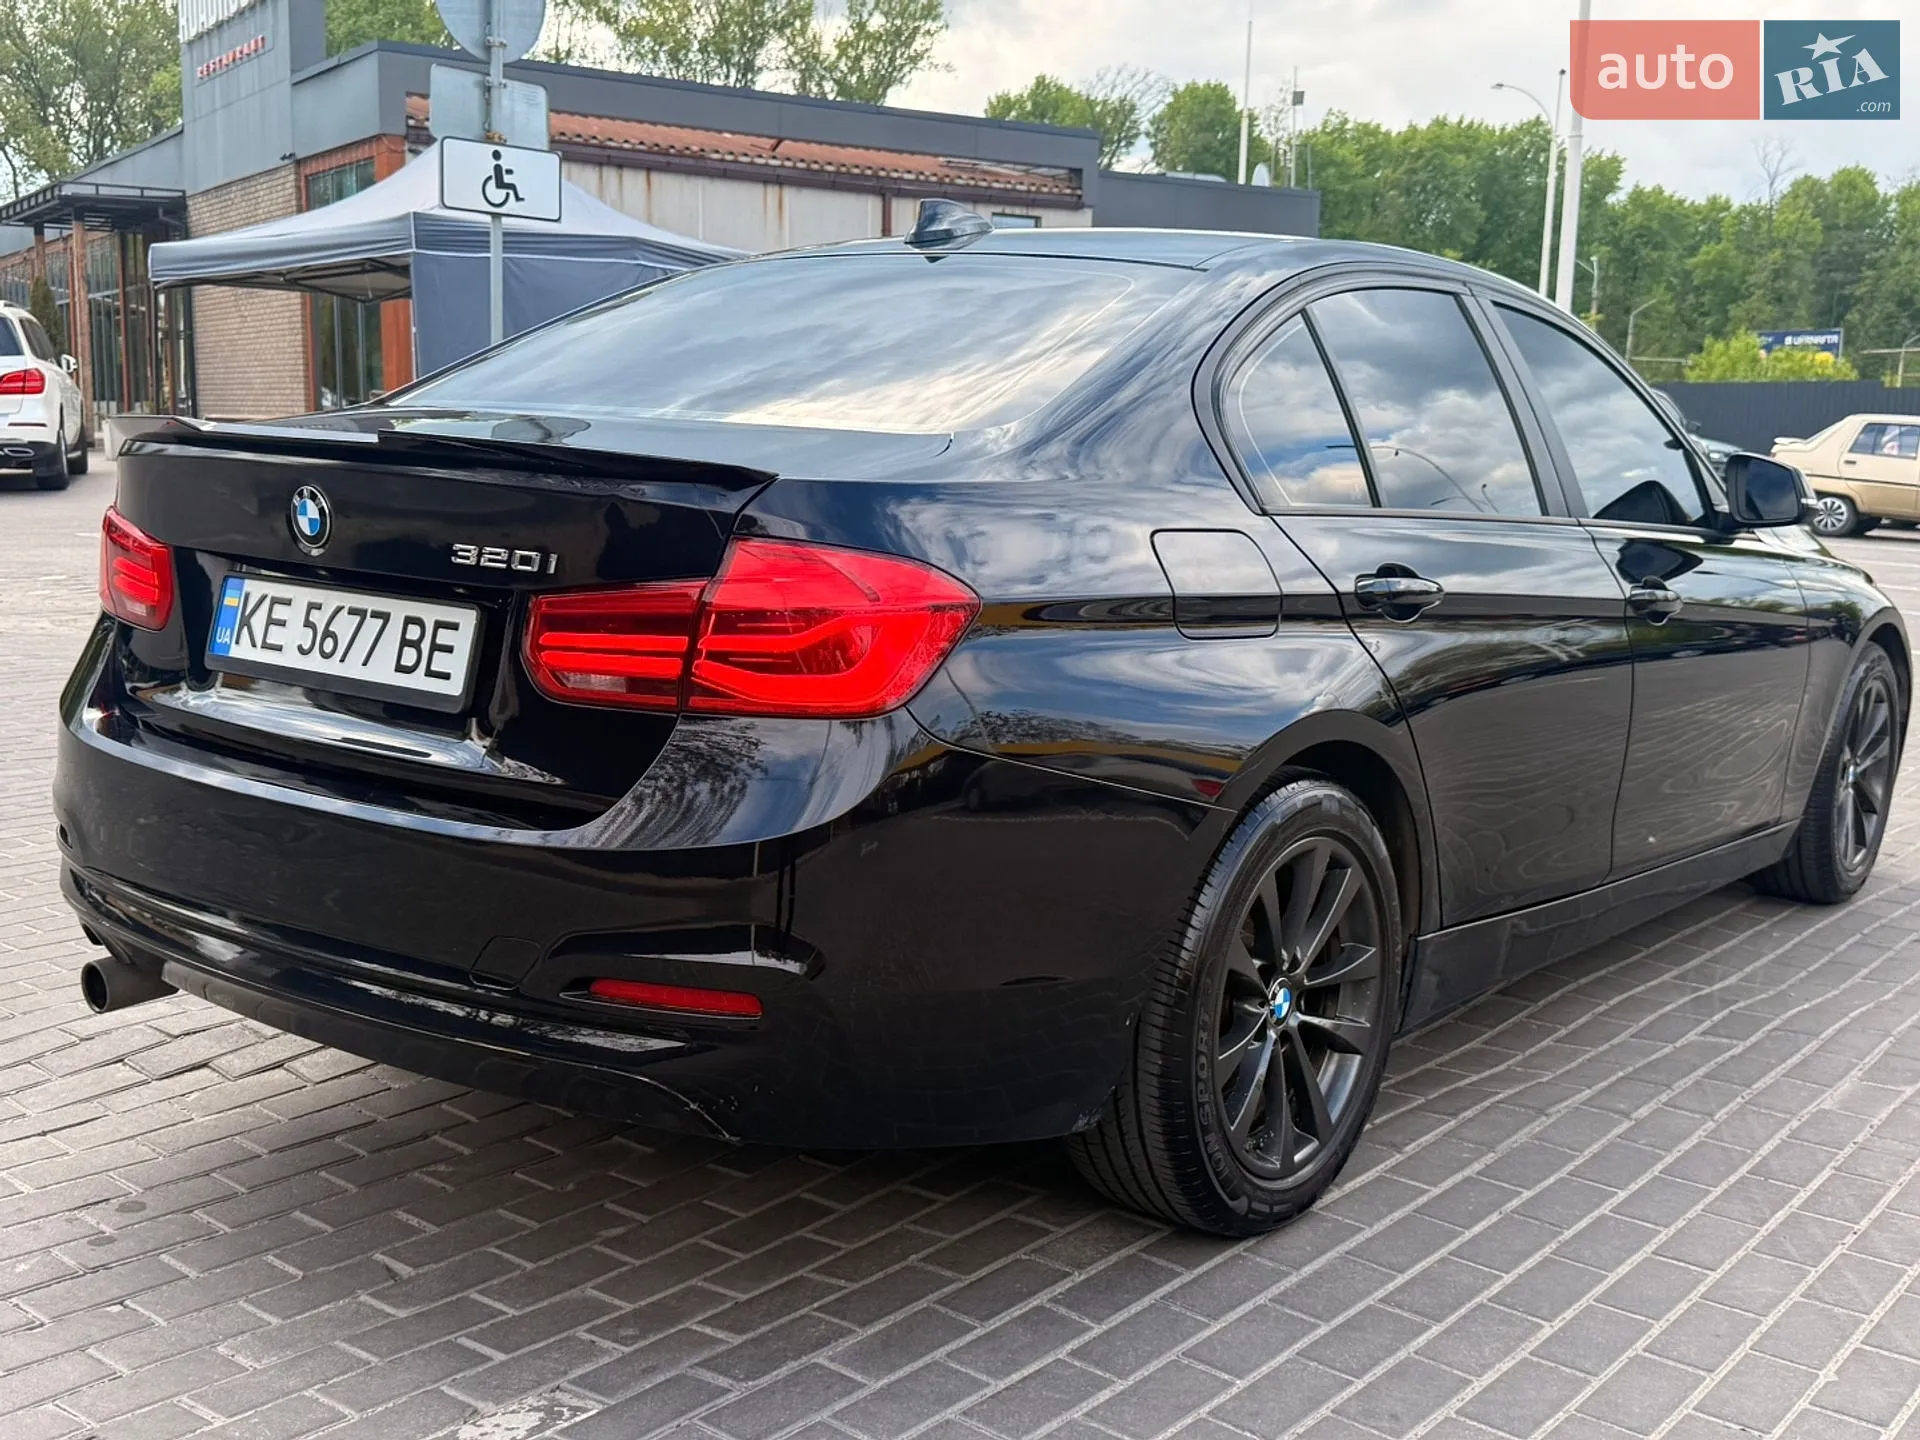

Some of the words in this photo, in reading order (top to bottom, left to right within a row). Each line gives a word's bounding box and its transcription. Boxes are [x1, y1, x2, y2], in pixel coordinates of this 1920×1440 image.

[216, 627, 231, 644] UA
[234, 591, 293, 653] KE
[298, 601, 391, 668] 5677
[395, 616, 460, 681] BE
[1196, 1005, 1214, 1125] SPORT
